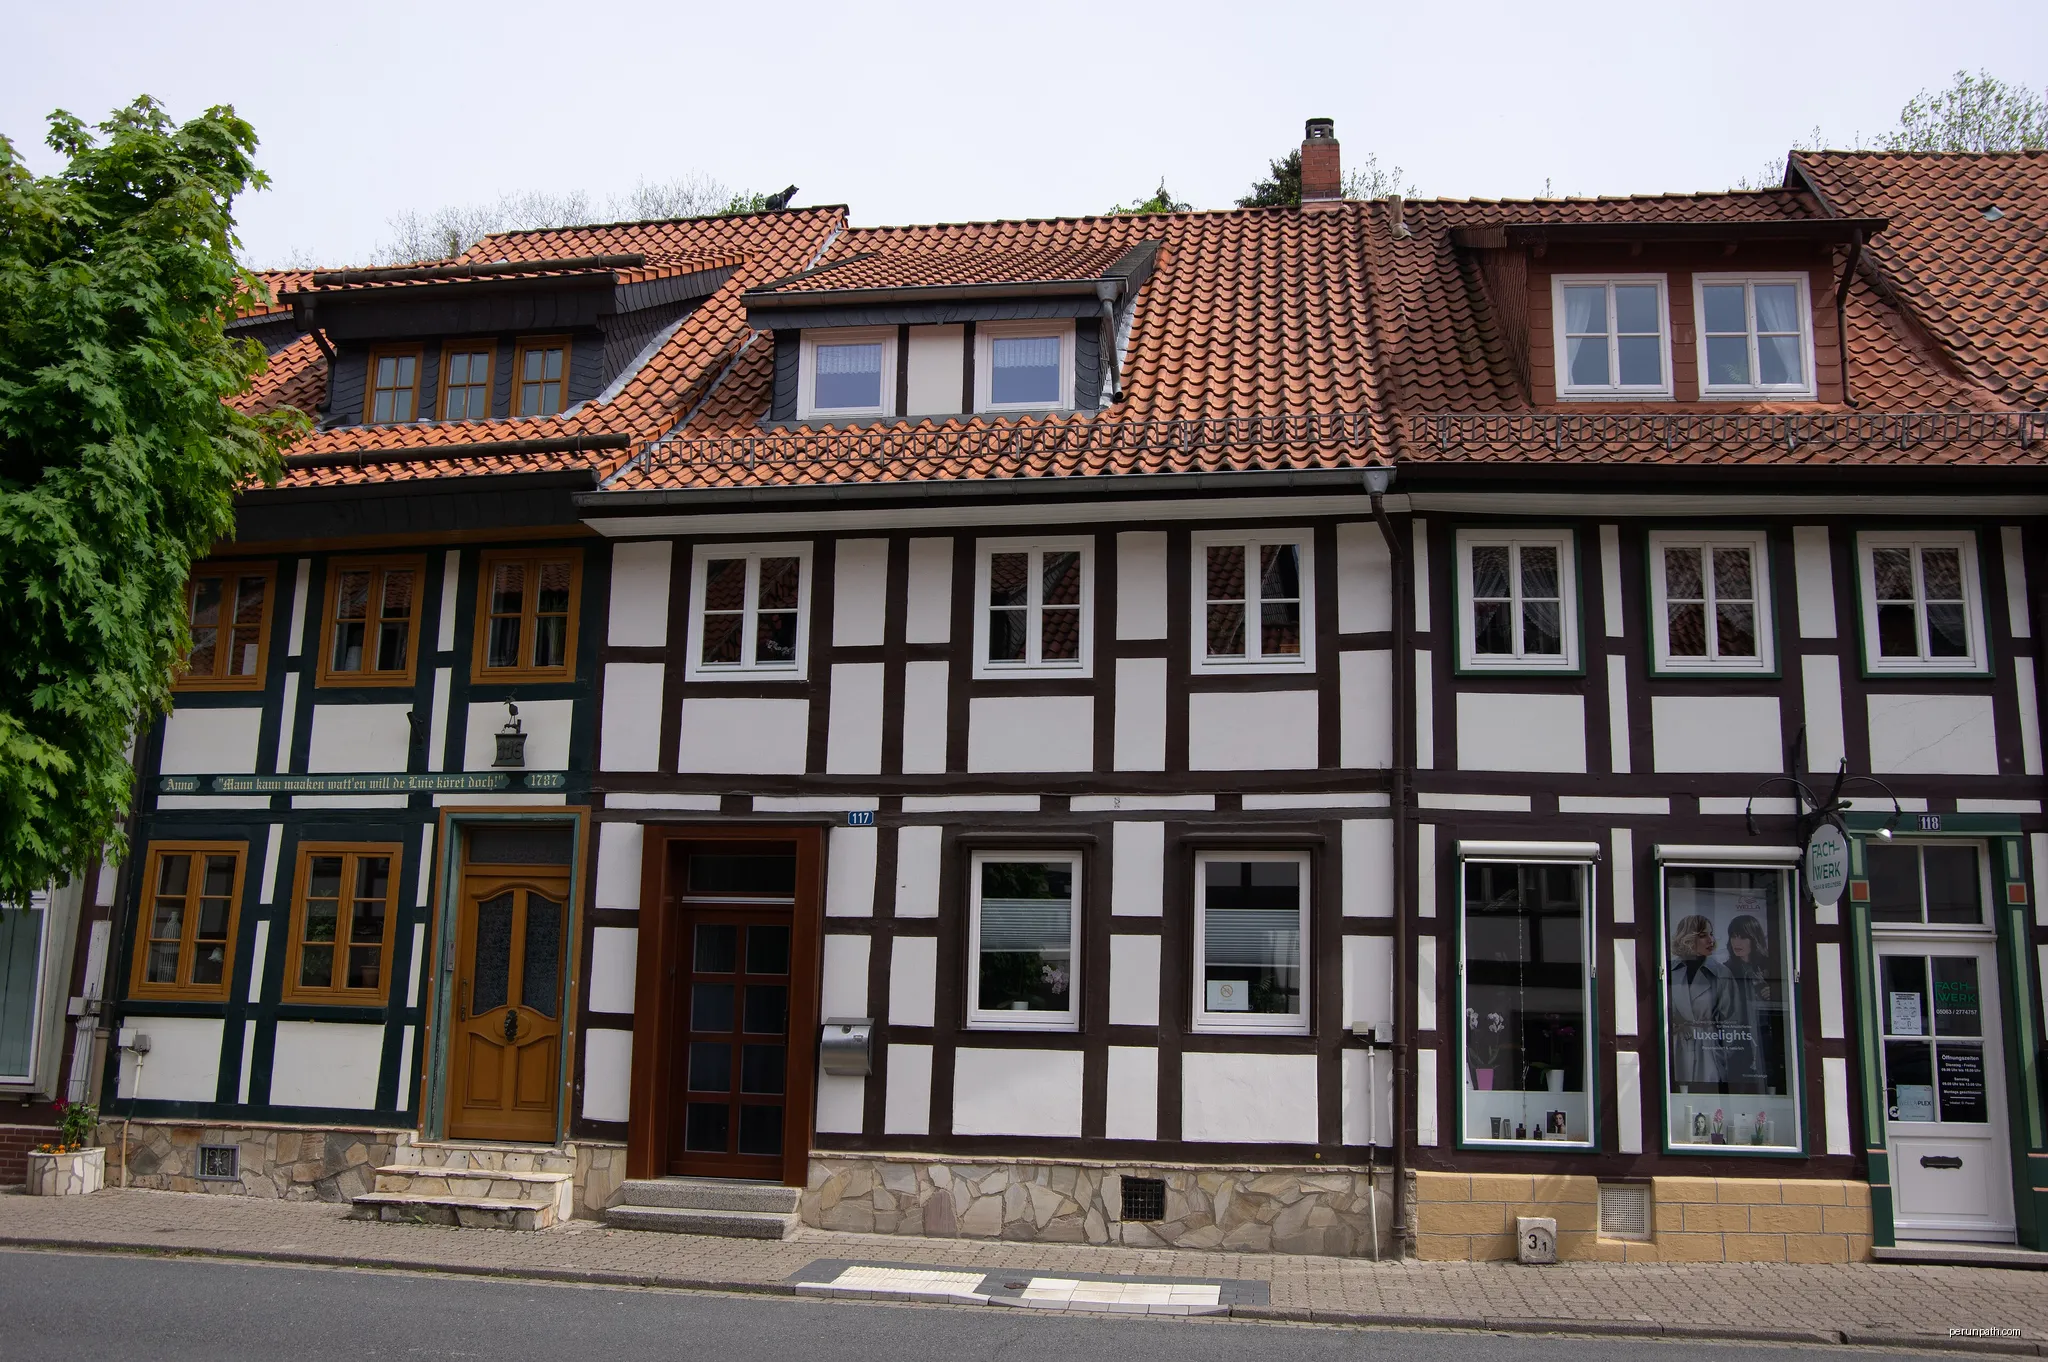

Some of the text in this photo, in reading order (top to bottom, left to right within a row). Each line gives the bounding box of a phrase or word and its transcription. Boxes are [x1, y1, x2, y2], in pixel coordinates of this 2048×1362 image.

[165, 778, 193, 791] Anno
[256, 778, 281, 790] kann
[284, 778, 325, 790] maaken
[369, 777, 390, 789] will
[393, 777, 406, 789] de
[436, 776, 465, 789] köret
[531, 774, 559, 787] 1787
[852, 812, 870, 824] 117
[1921, 816, 1939, 830] 118
[1814, 861, 1841, 881] WERK
[1937, 993, 1976, 1002] WERK
[1693, 1029, 1753, 1043] luxelights
[1941, 1054, 1980, 1062] Öffnungszeiten
[1528, 1234, 1548, 1252] 3.1
